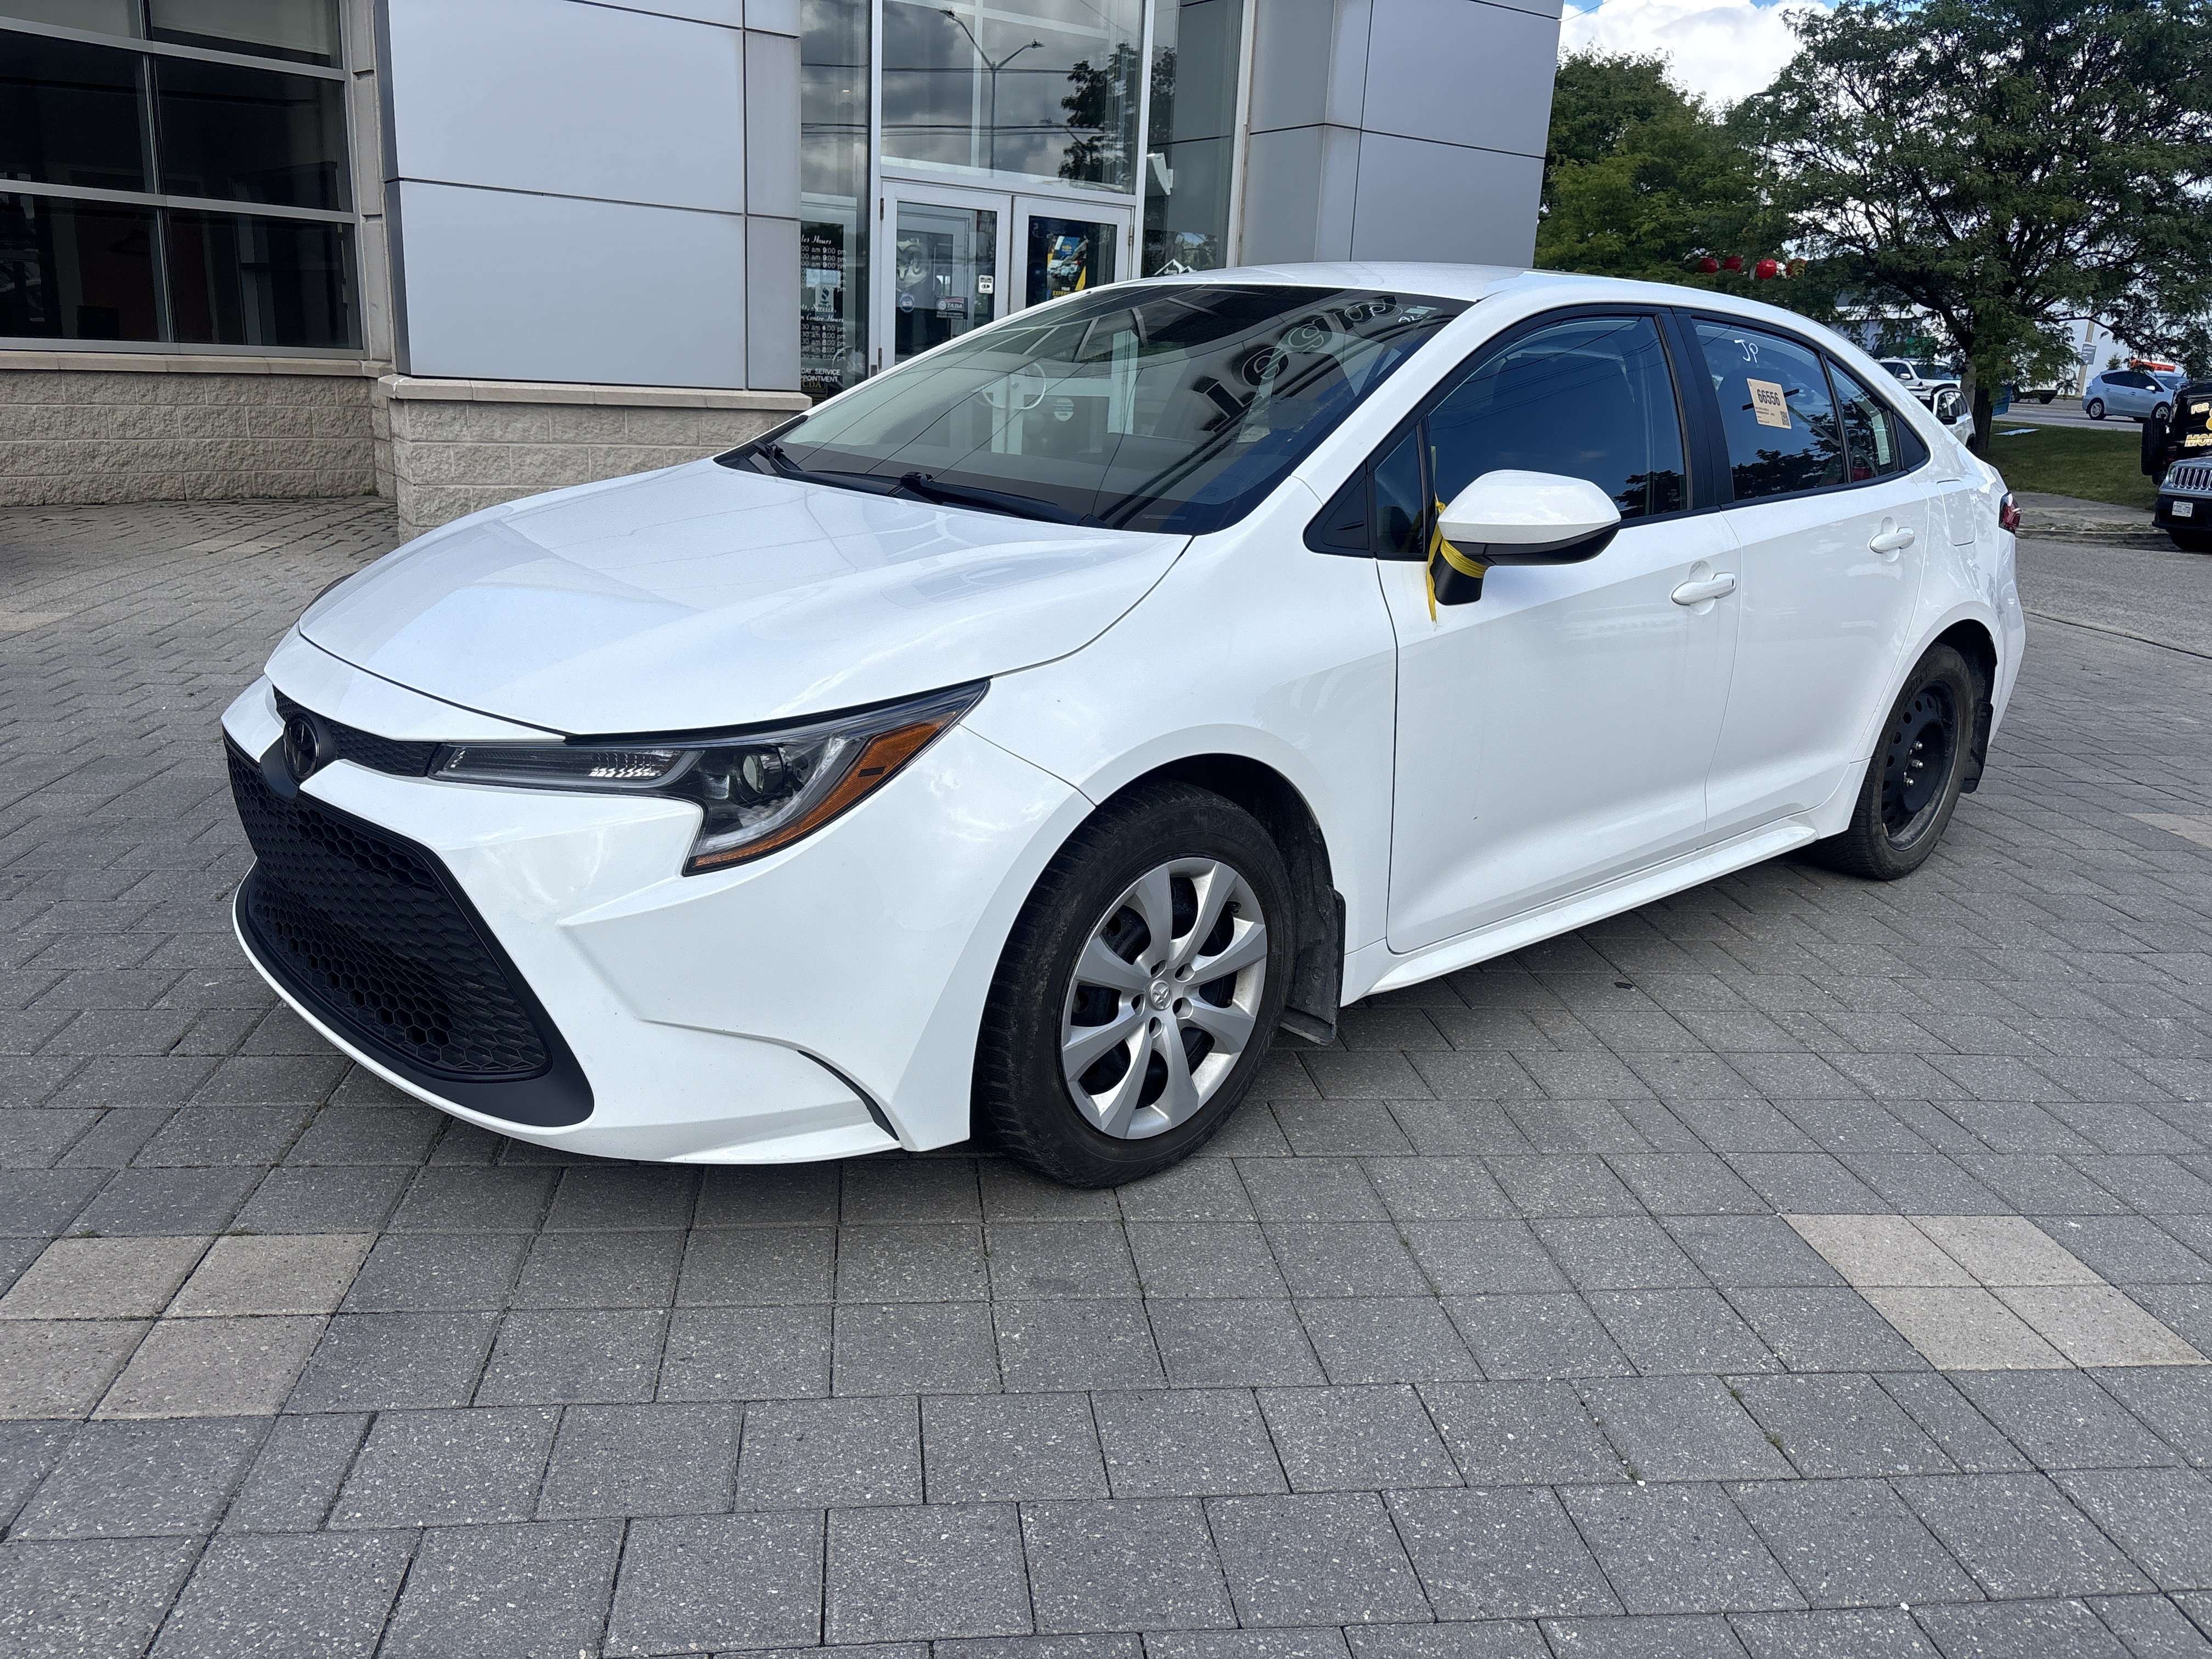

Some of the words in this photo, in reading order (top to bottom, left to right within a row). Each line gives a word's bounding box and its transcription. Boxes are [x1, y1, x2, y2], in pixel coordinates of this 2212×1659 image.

[811, 235, 832, 245] Hours
[827, 314, 844, 323] Hours
[1757, 389, 1781, 407] 66556
[2191, 402, 2210, 415] FOR
